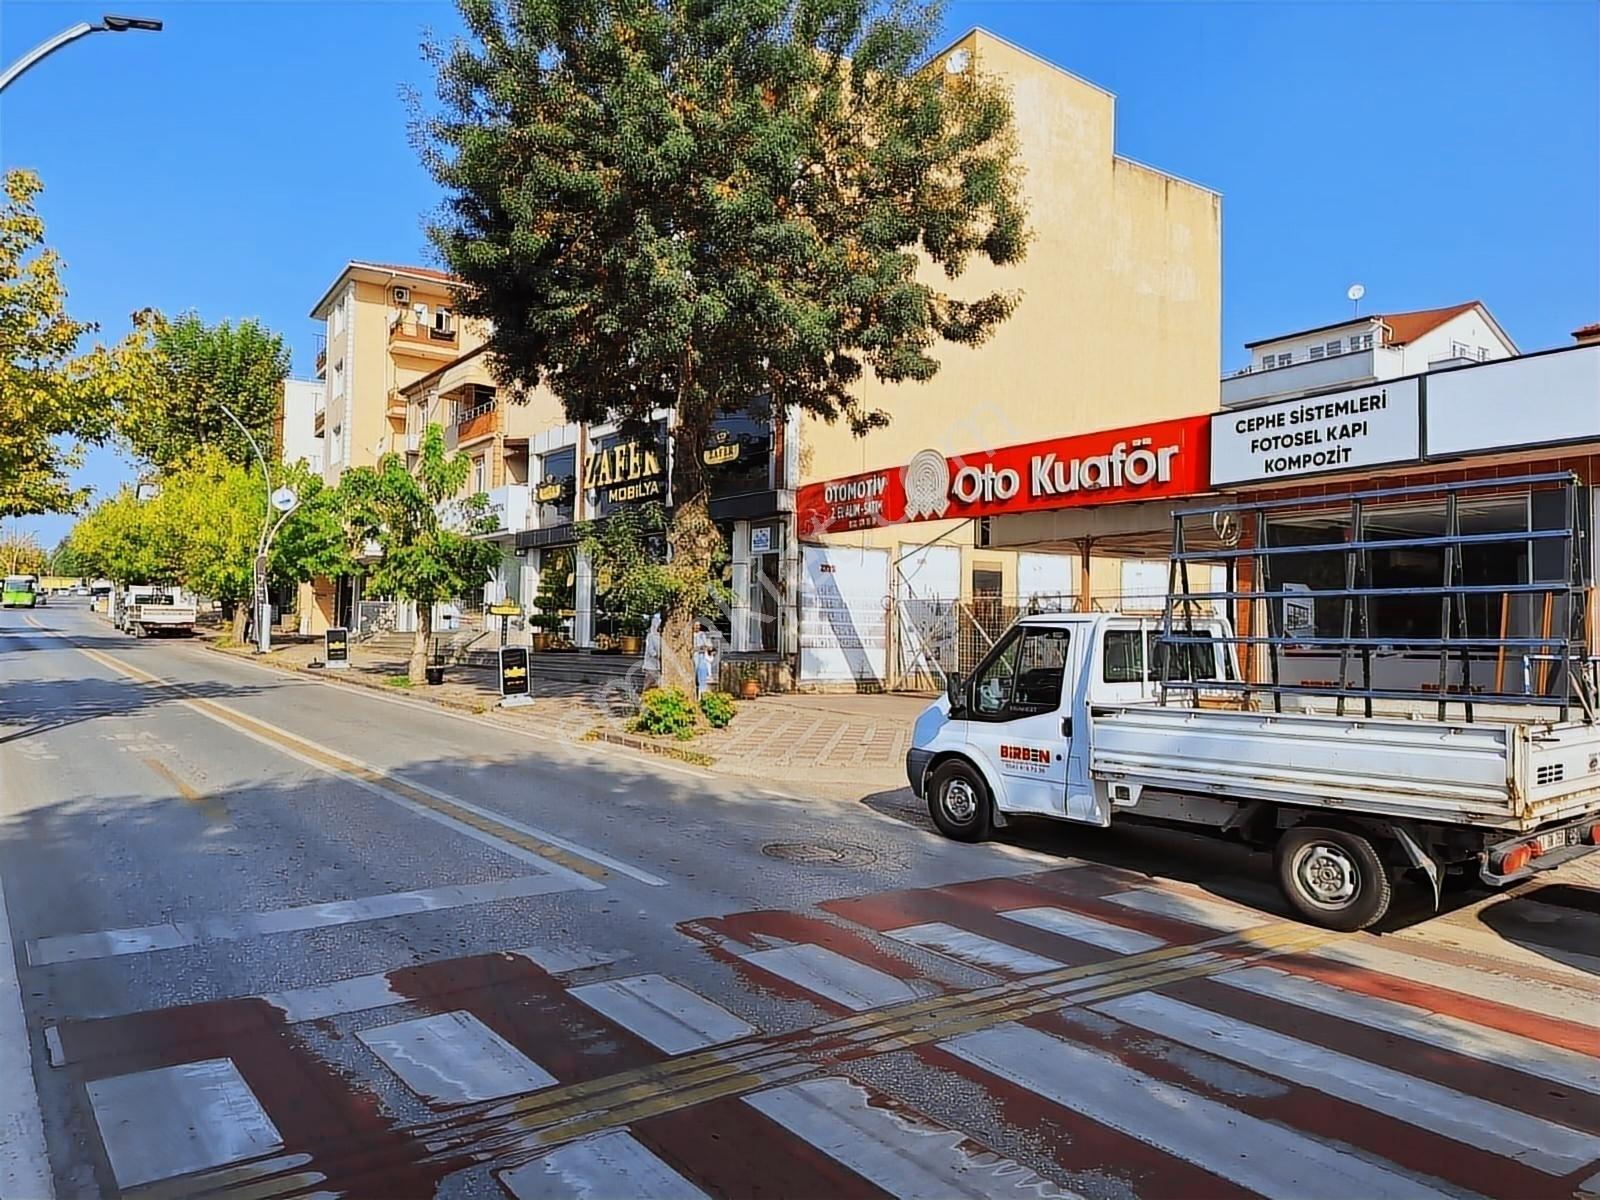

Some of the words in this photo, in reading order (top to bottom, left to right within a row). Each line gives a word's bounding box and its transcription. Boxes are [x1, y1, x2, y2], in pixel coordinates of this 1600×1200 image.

[1235, 412, 1286, 433] CEPHE
[1289, 389, 1387, 425] SİSTEMLERİ
[1251, 429, 1322, 453] FOTOSEL
[1326, 421, 1368, 442] KAPI
[952, 463, 1020, 503] Oto
[1030, 437, 1179, 497] Kuaför
[1264, 445, 1352, 474] KOMPOZİT
